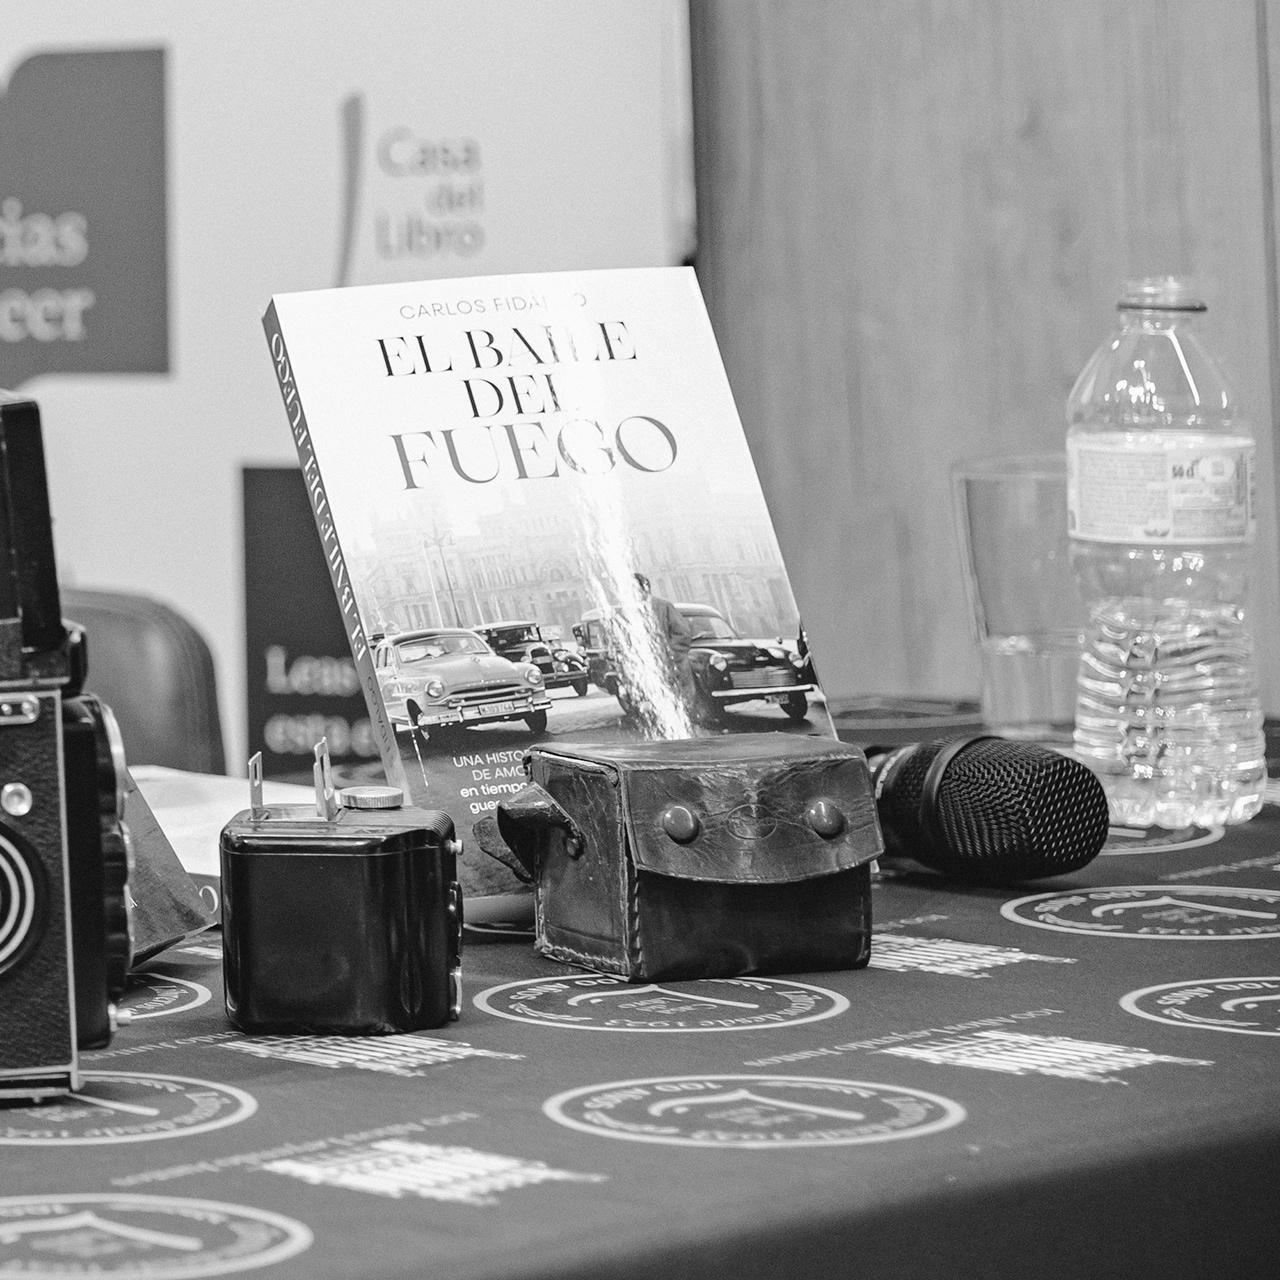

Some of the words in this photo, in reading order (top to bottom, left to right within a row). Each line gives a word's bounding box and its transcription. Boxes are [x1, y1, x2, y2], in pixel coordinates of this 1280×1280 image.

[375, 125, 482, 179] Casa
[374, 213, 487, 260] Libro
[400, 299, 486, 319] CARLOS
[377, 334, 453, 376] EL
[464, 321, 637, 370] BAILE
[388, 415, 678, 491] FUEGO
[453, 754, 484, 767] UNA
[472, 768, 491, 781] DE
[495, 765, 526, 779] AMO
[460, 787, 479, 797] en
[510, 982, 570, 1000] AÑOS
[1215, 982, 1279, 991] 100
[1156, 987, 1215, 1005] AÑOS
[604, 1018, 685, 1028] 1923
[699, 1013, 782, 1027] desde
[655, 1081, 722, 1092] 100
